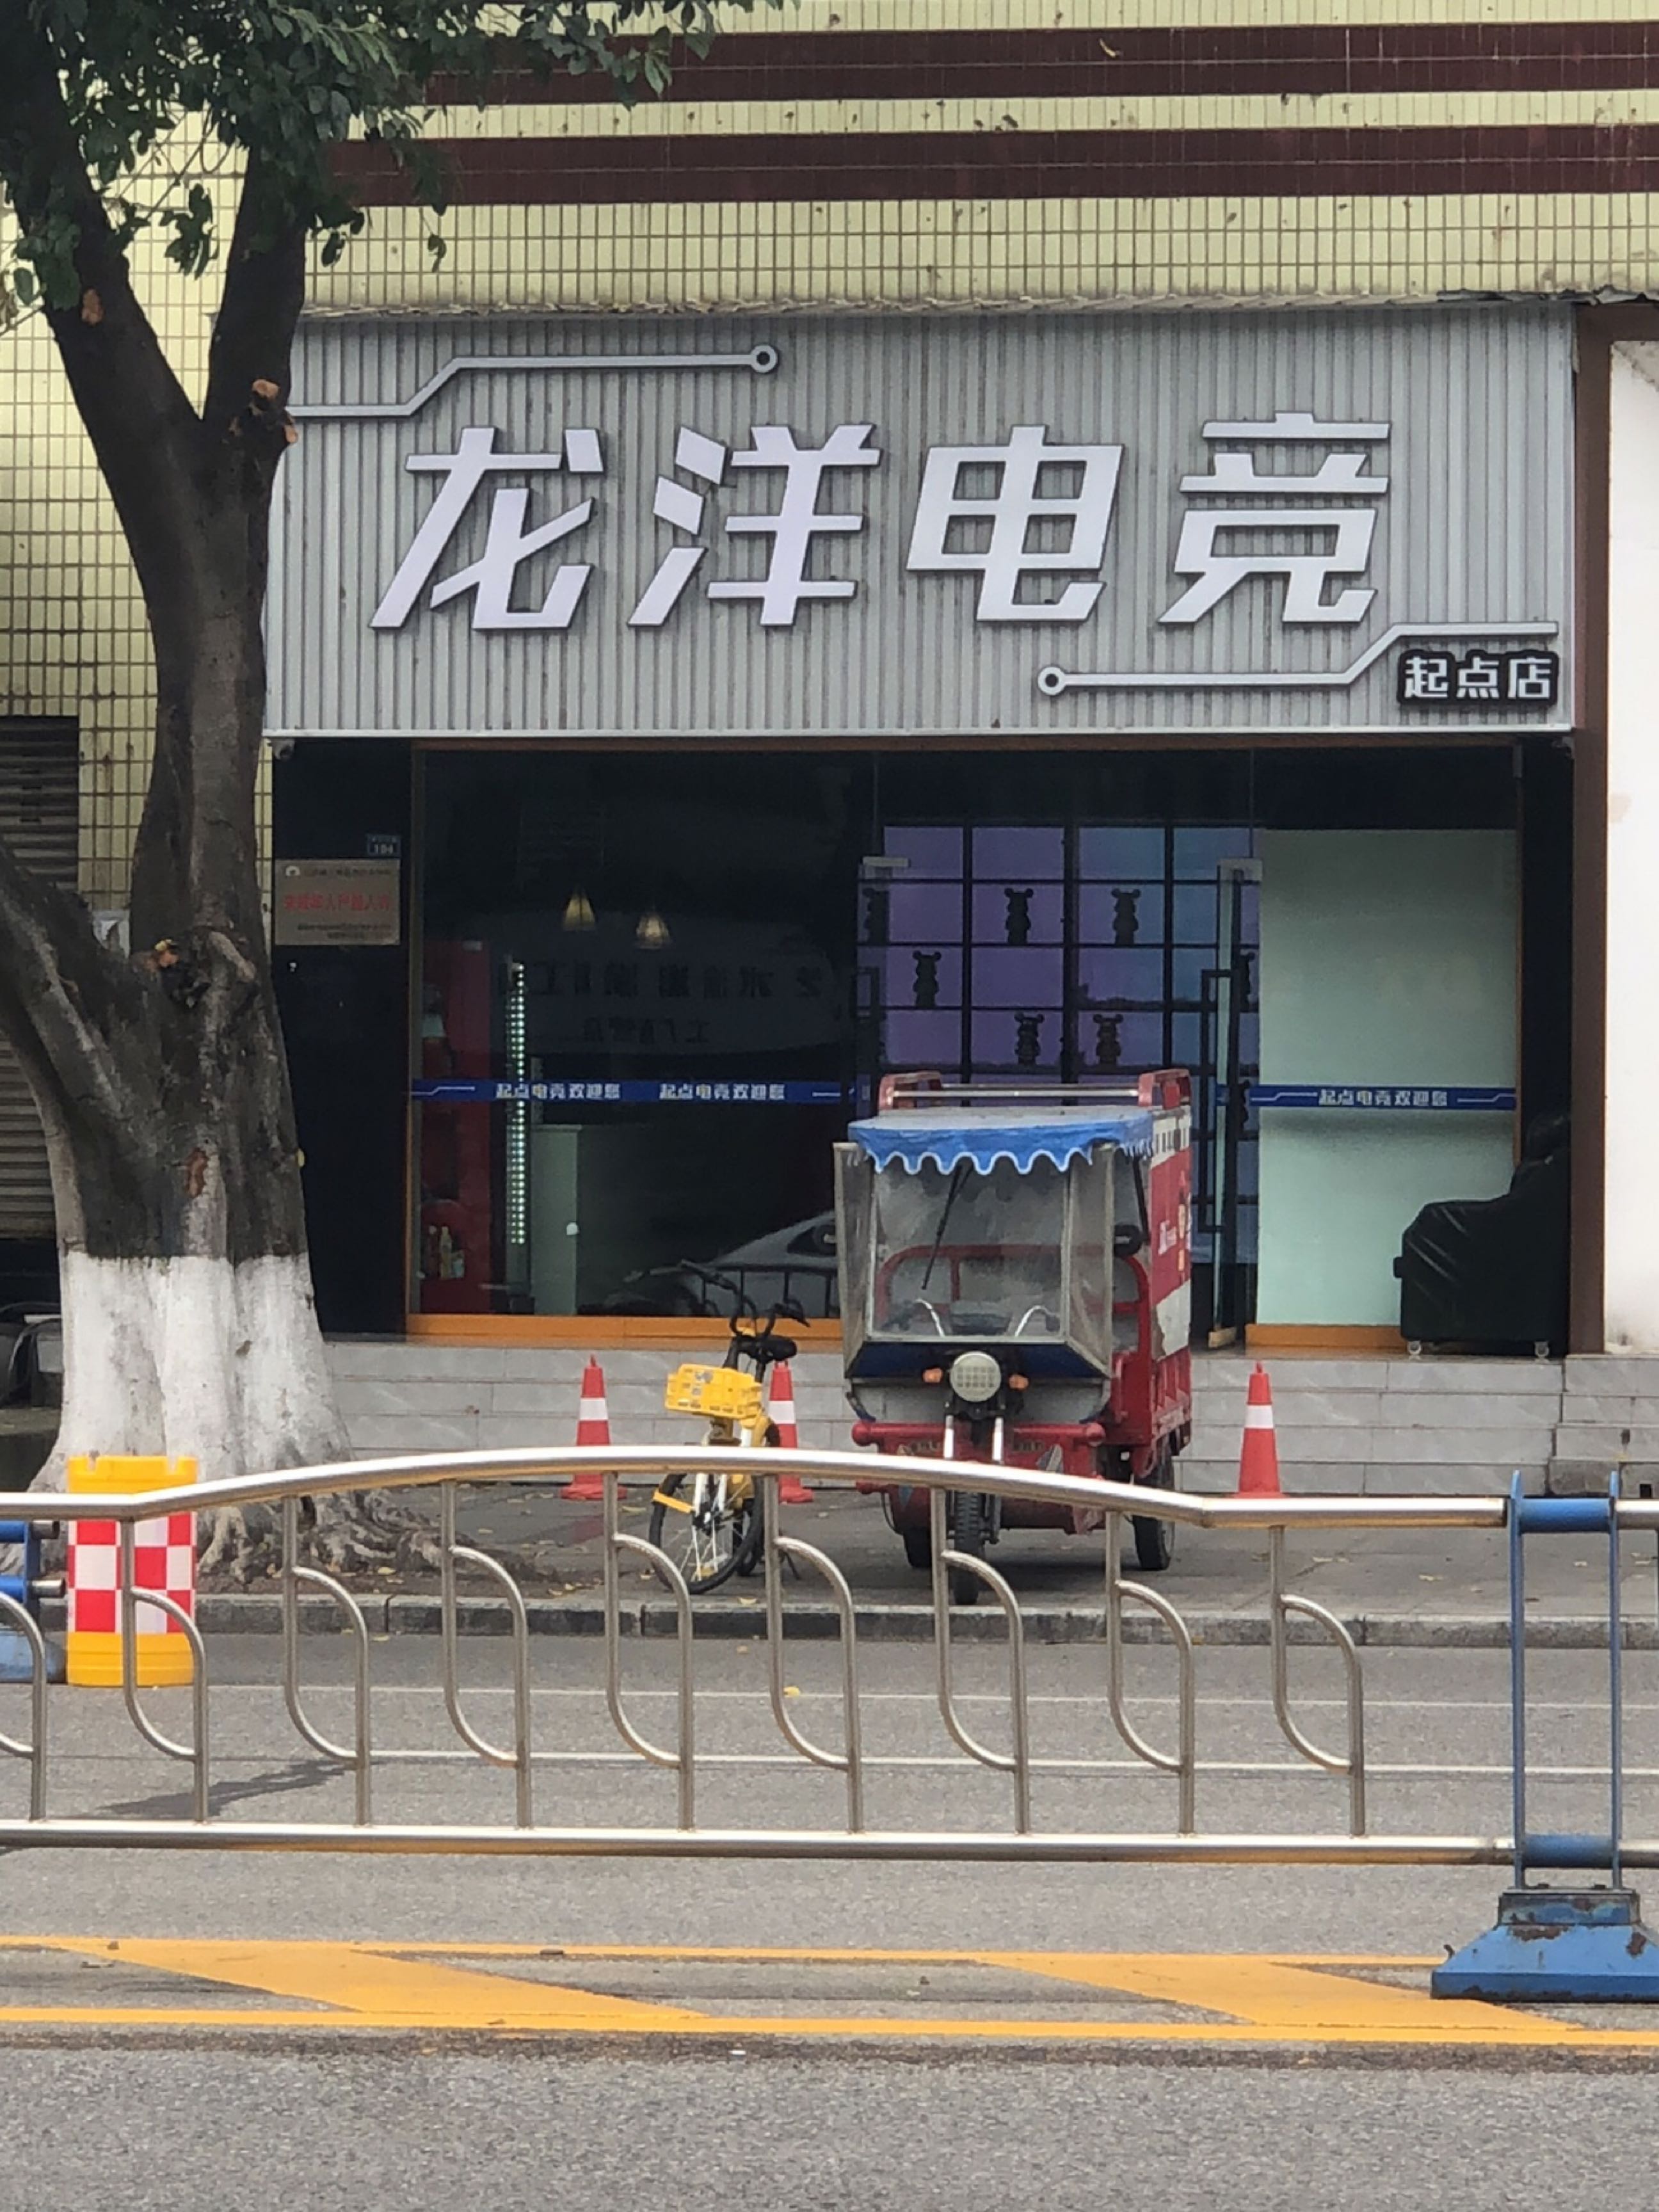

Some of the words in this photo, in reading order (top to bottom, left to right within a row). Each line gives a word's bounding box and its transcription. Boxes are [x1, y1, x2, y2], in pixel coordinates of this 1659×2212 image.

[369, 412, 1391, 632] 龙洋电竞
[1404, 655, 1552, 699] 起点店
